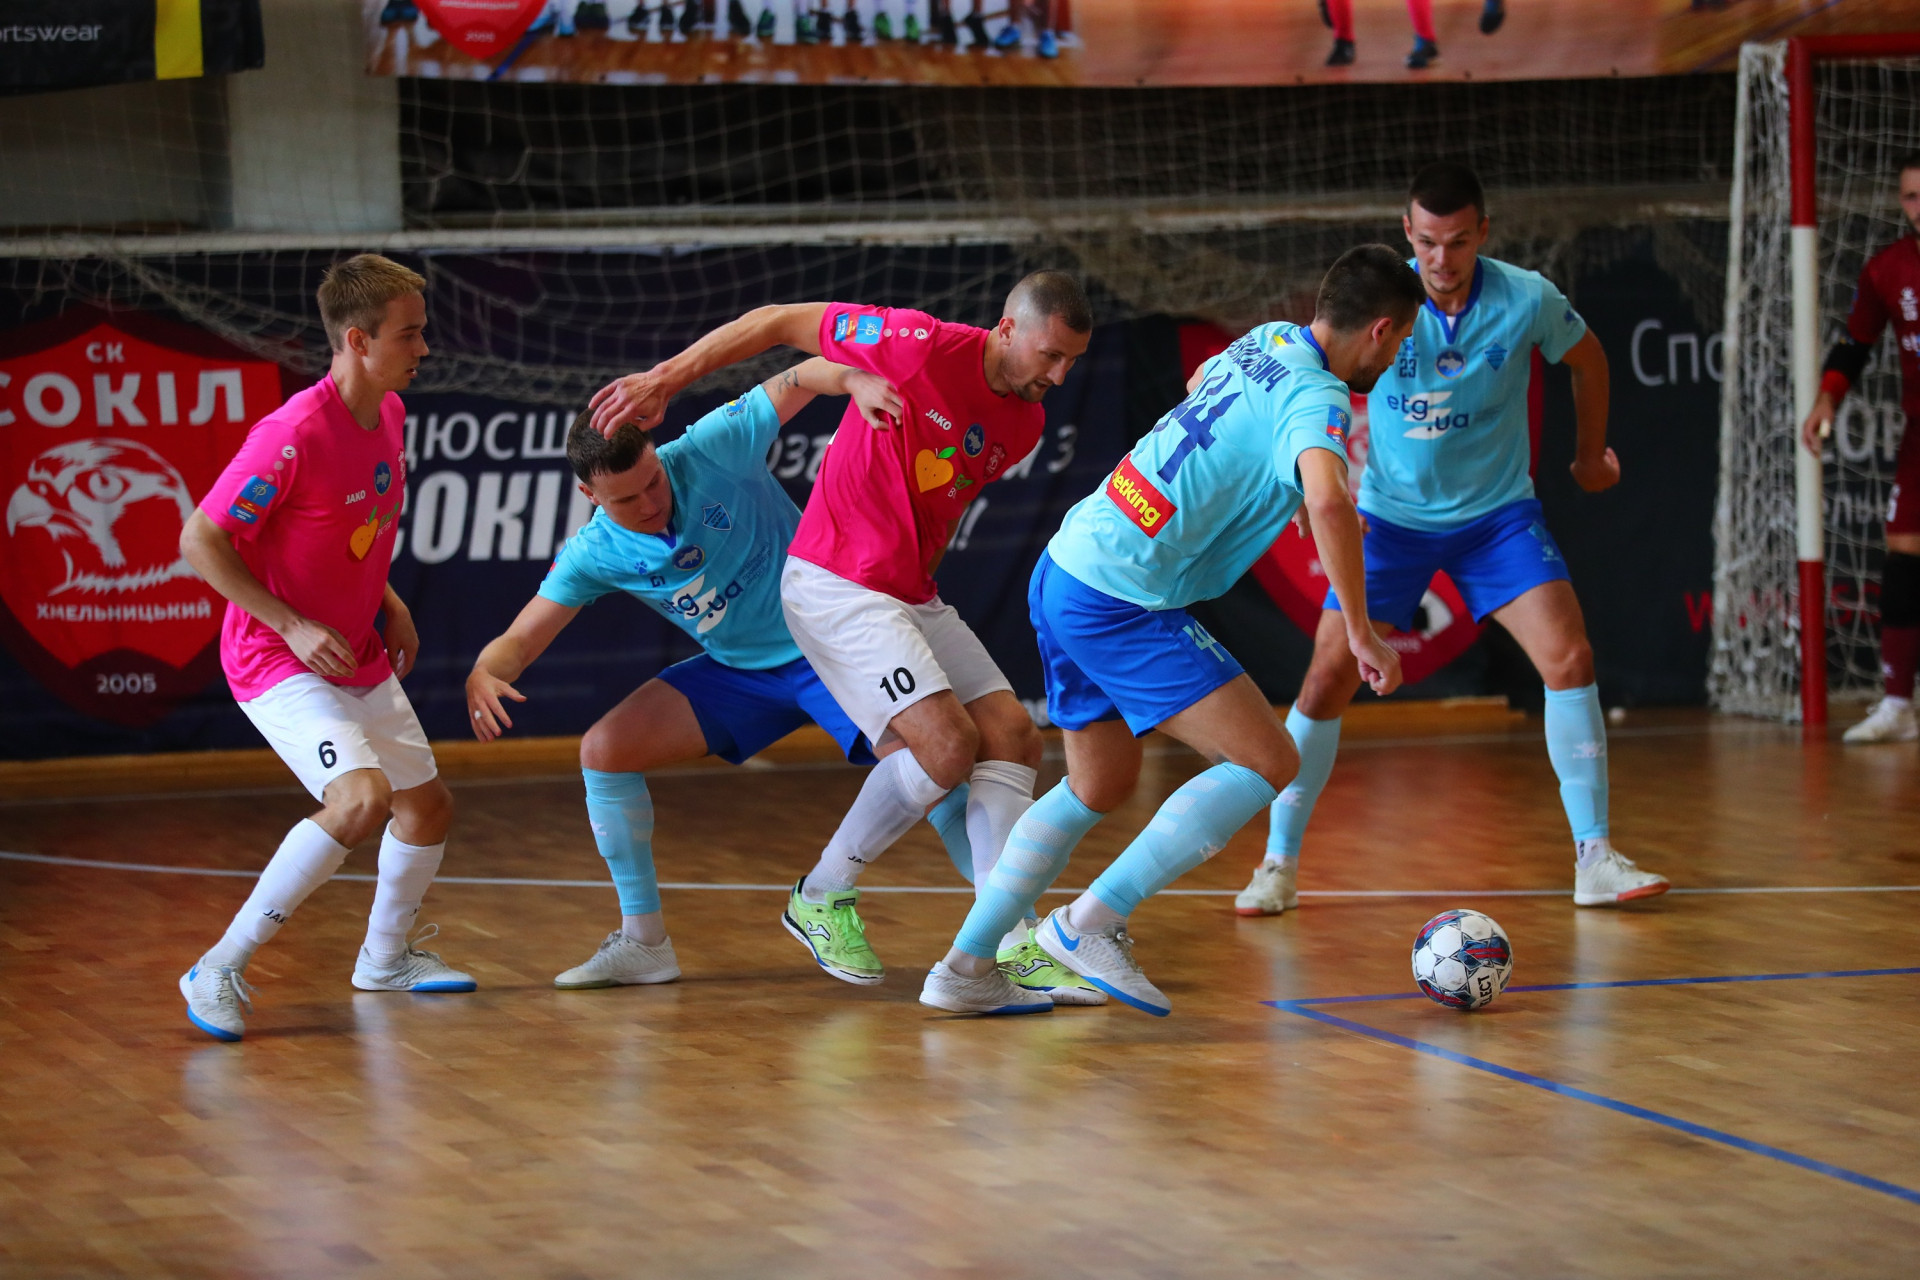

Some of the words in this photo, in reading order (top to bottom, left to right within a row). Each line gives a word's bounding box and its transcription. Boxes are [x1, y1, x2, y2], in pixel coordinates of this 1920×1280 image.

[0, 24, 103, 42] rtswear
[86, 341, 125, 363] СК
[1399, 358, 1417, 378] 23
[925, 408, 953, 431] JAKO
[345, 489, 366, 504] JAKO
[1111, 464, 1162, 528] betking
[391, 470, 594, 565] ОКІ
[36, 597, 211, 622] ХМЕЛЬНИЦЬКИЙ
[96, 673, 157, 694] 2005
[879, 666, 916, 703] 10
[318, 740, 337, 769] 6
[262, 909, 288, 925] JAK
[1477, 974, 1493, 1007] LECT
